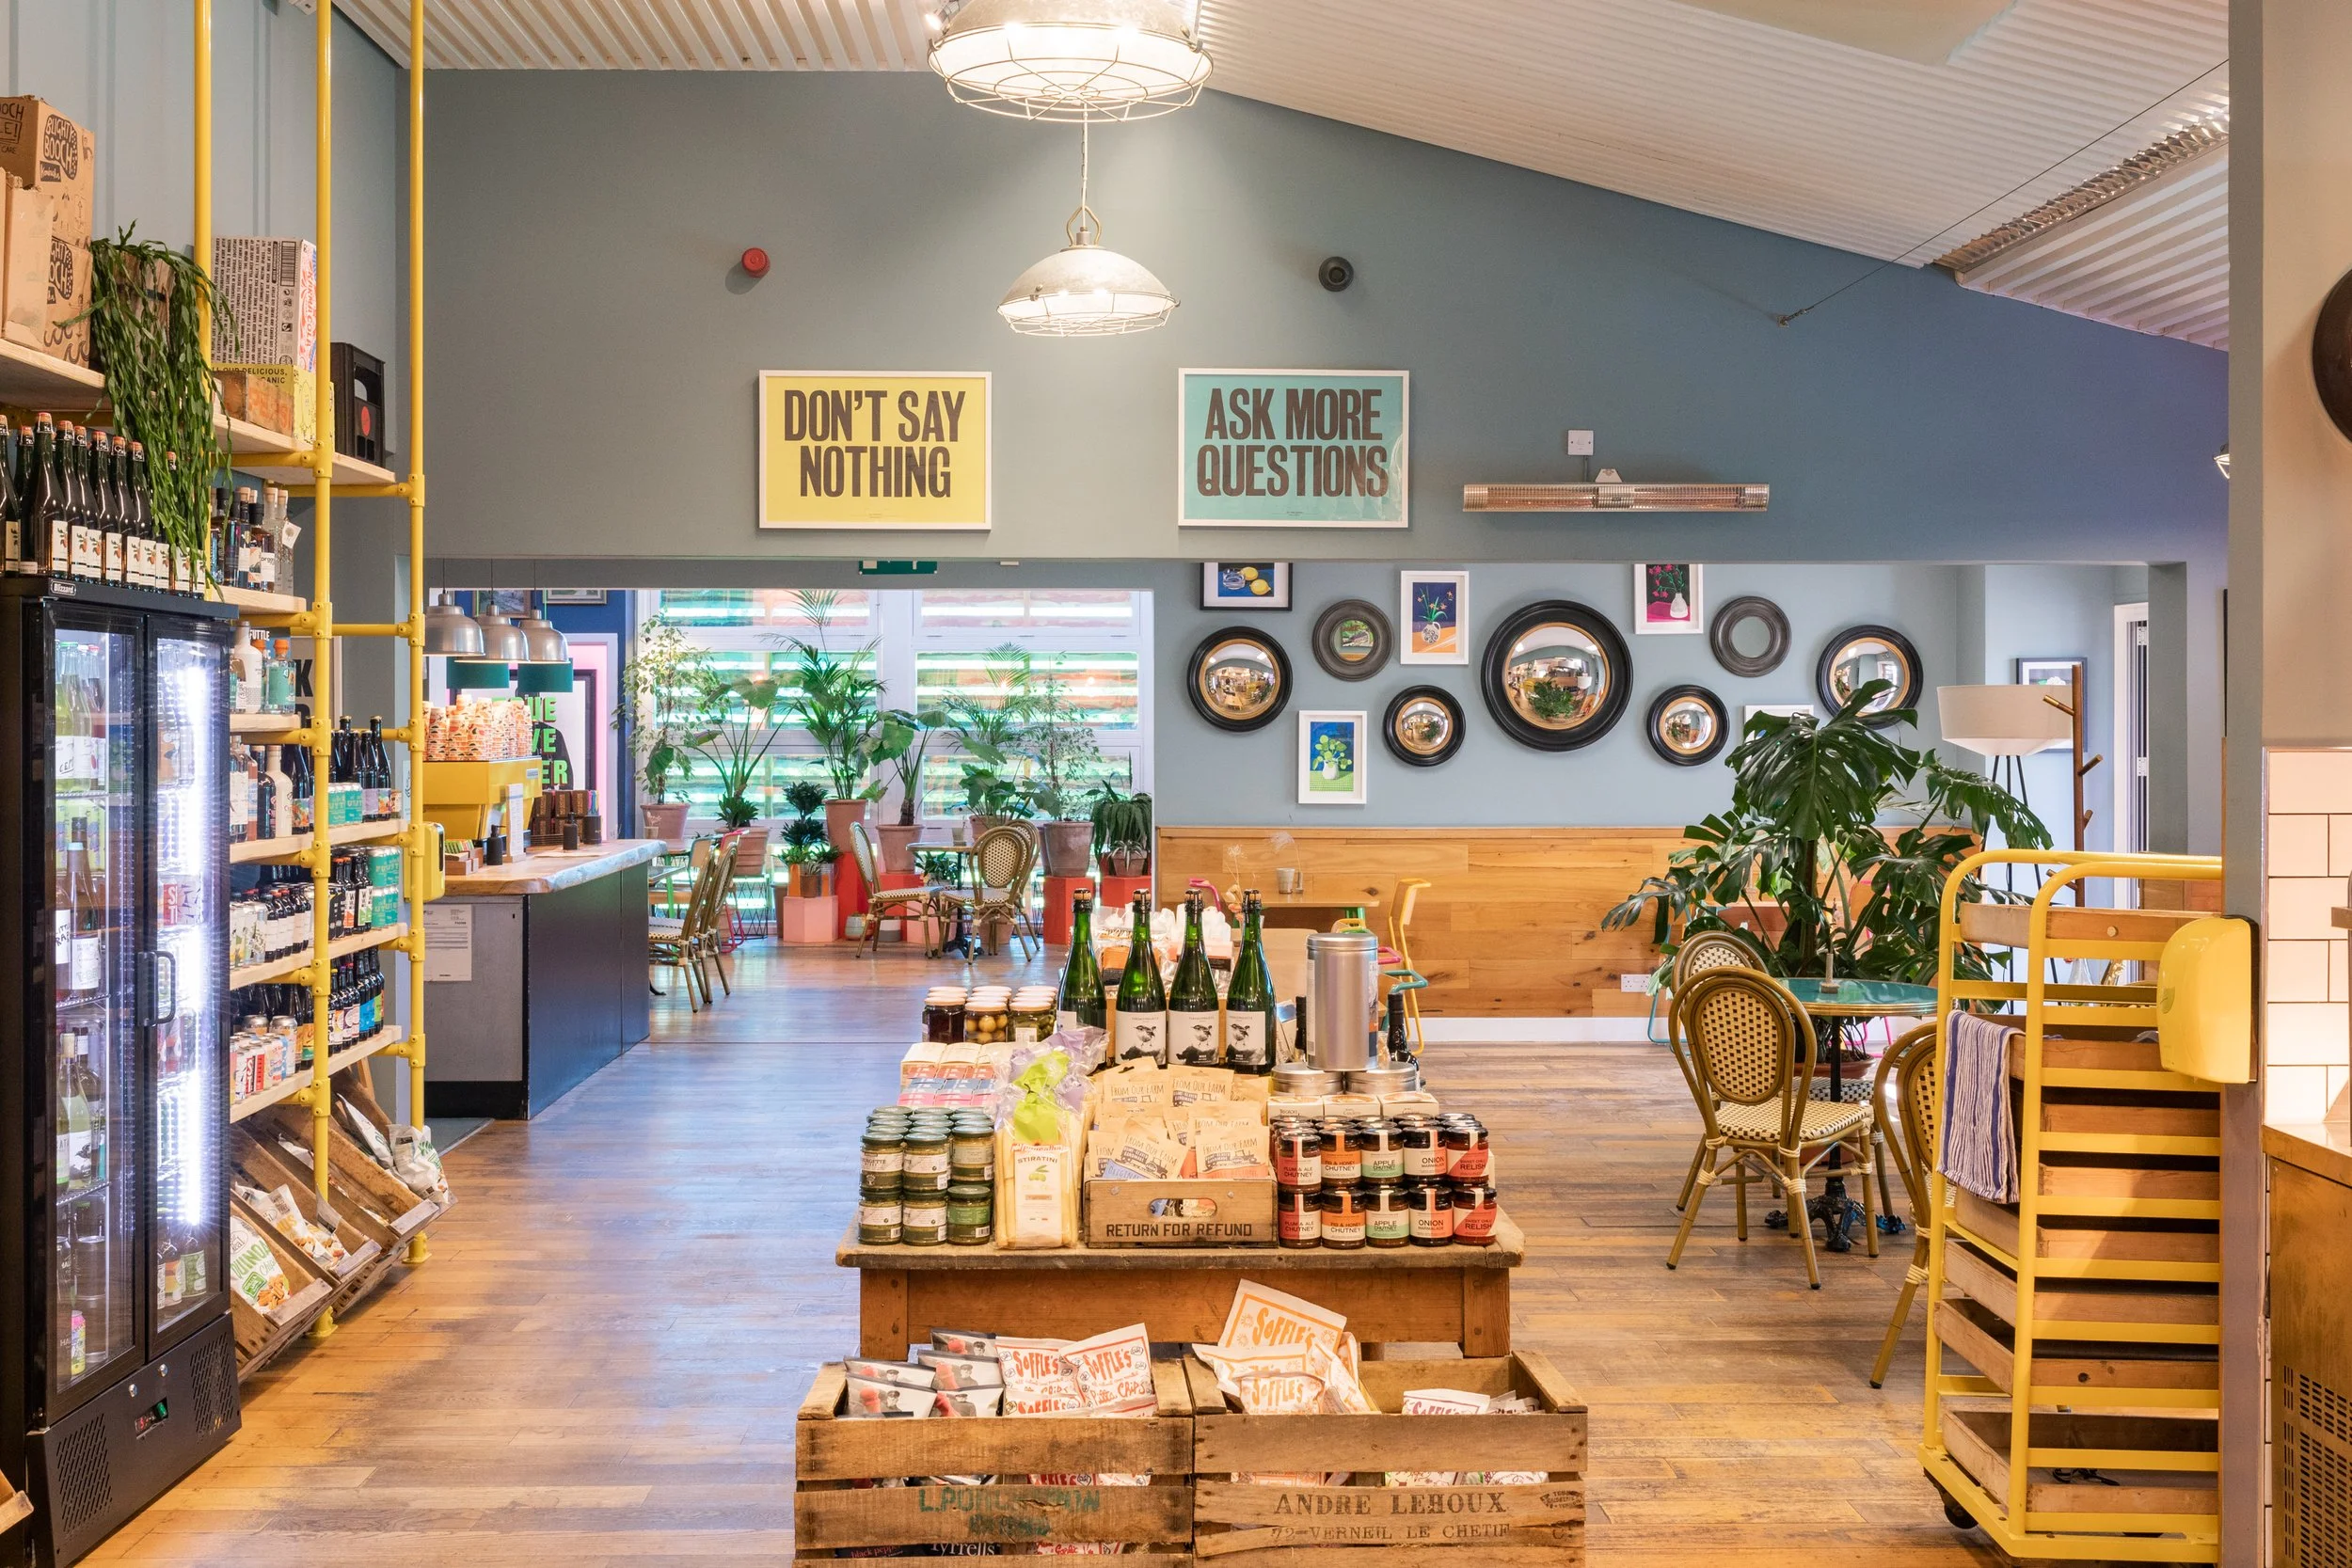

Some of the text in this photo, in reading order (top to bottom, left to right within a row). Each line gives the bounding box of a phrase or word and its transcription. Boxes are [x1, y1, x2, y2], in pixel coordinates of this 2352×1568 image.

[45, 117, 76, 143] BLIGHTY
[44, 135, 74, 177] BOOCH
[785, 390, 965, 442] DON'T SAY
[1204, 388, 1382, 440] ASK MORE
[800, 446, 950, 498] NOTHING
[1198, 444, 1389, 498] QUESTIONS
[54, 583, 74, 594] Blizzard
[1111, 1084, 1165, 1096] FROM OUR FARM
[1172, 1079, 1226, 1095] FROM OUR FARM
[1125, 1134, 1144, 1149] FROM
[1145, 1143, 1159, 1155] OUR
[1160, 1148, 1178, 1167] FARM
[1203, 1137, 1258, 1155] FROM OUR FARM
[1017, 1155, 1058, 1164] STIRATINI
[1422, 1156, 1444, 1164] ONION
[1106, 1223, 1252, 1237] RETURN FOR REFUND
[1252, 1306, 1316, 1351] SOFFLE'S
[1012, 1350, 1059, 1380] SOFFLE'S
[1083, 1348, 1132, 1381] SOFFLE'S
[1252, 1377, 1304, 1406] SOFFLE'S
[1273, 1491, 1509, 1516] ANDRE LEHOUX
[1406, 1525, 1431, 1539] LE
[1442, 1523, 1511, 1539] CHETIF
[930, 1543, 995, 1557] Tyrrells
